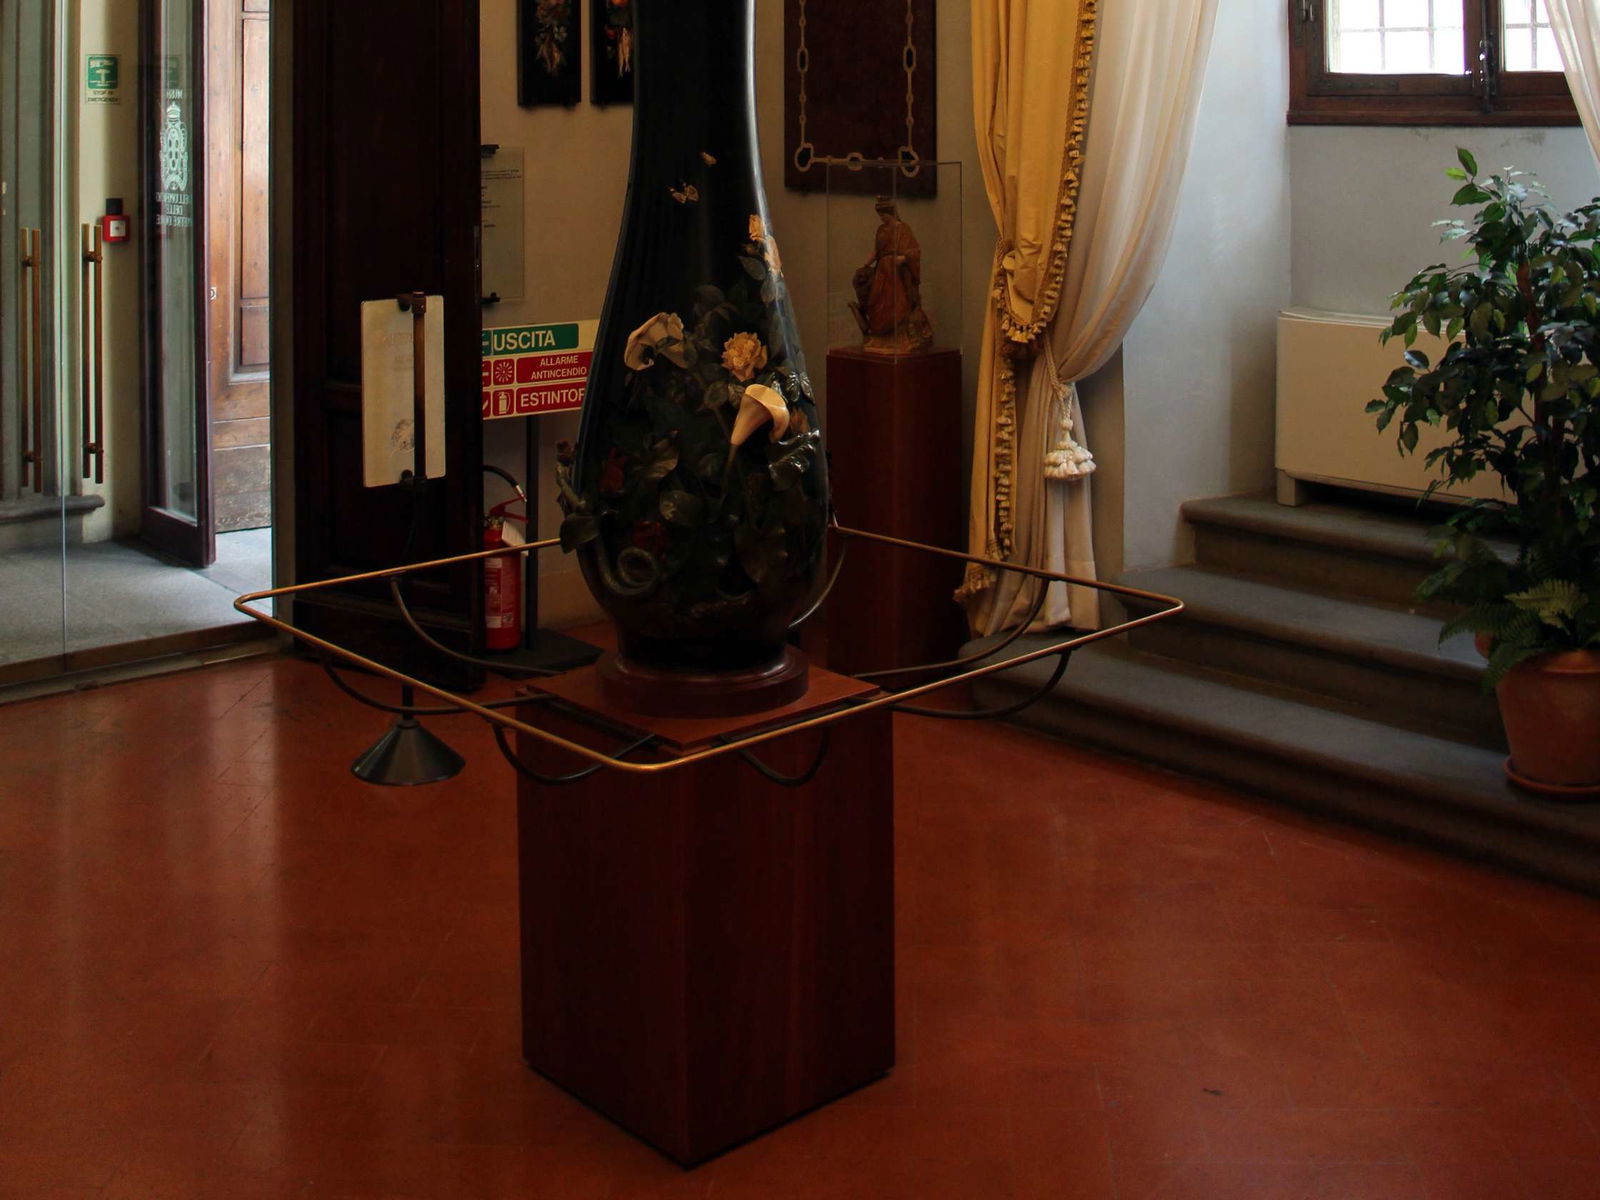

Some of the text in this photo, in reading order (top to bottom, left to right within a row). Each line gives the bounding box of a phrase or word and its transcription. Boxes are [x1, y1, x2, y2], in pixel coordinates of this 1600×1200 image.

[493, 330, 556, 351] USCITA
[539, 355, 579, 367] ALLARME
[530, 366, 588, 380] ANTINCENDIO
